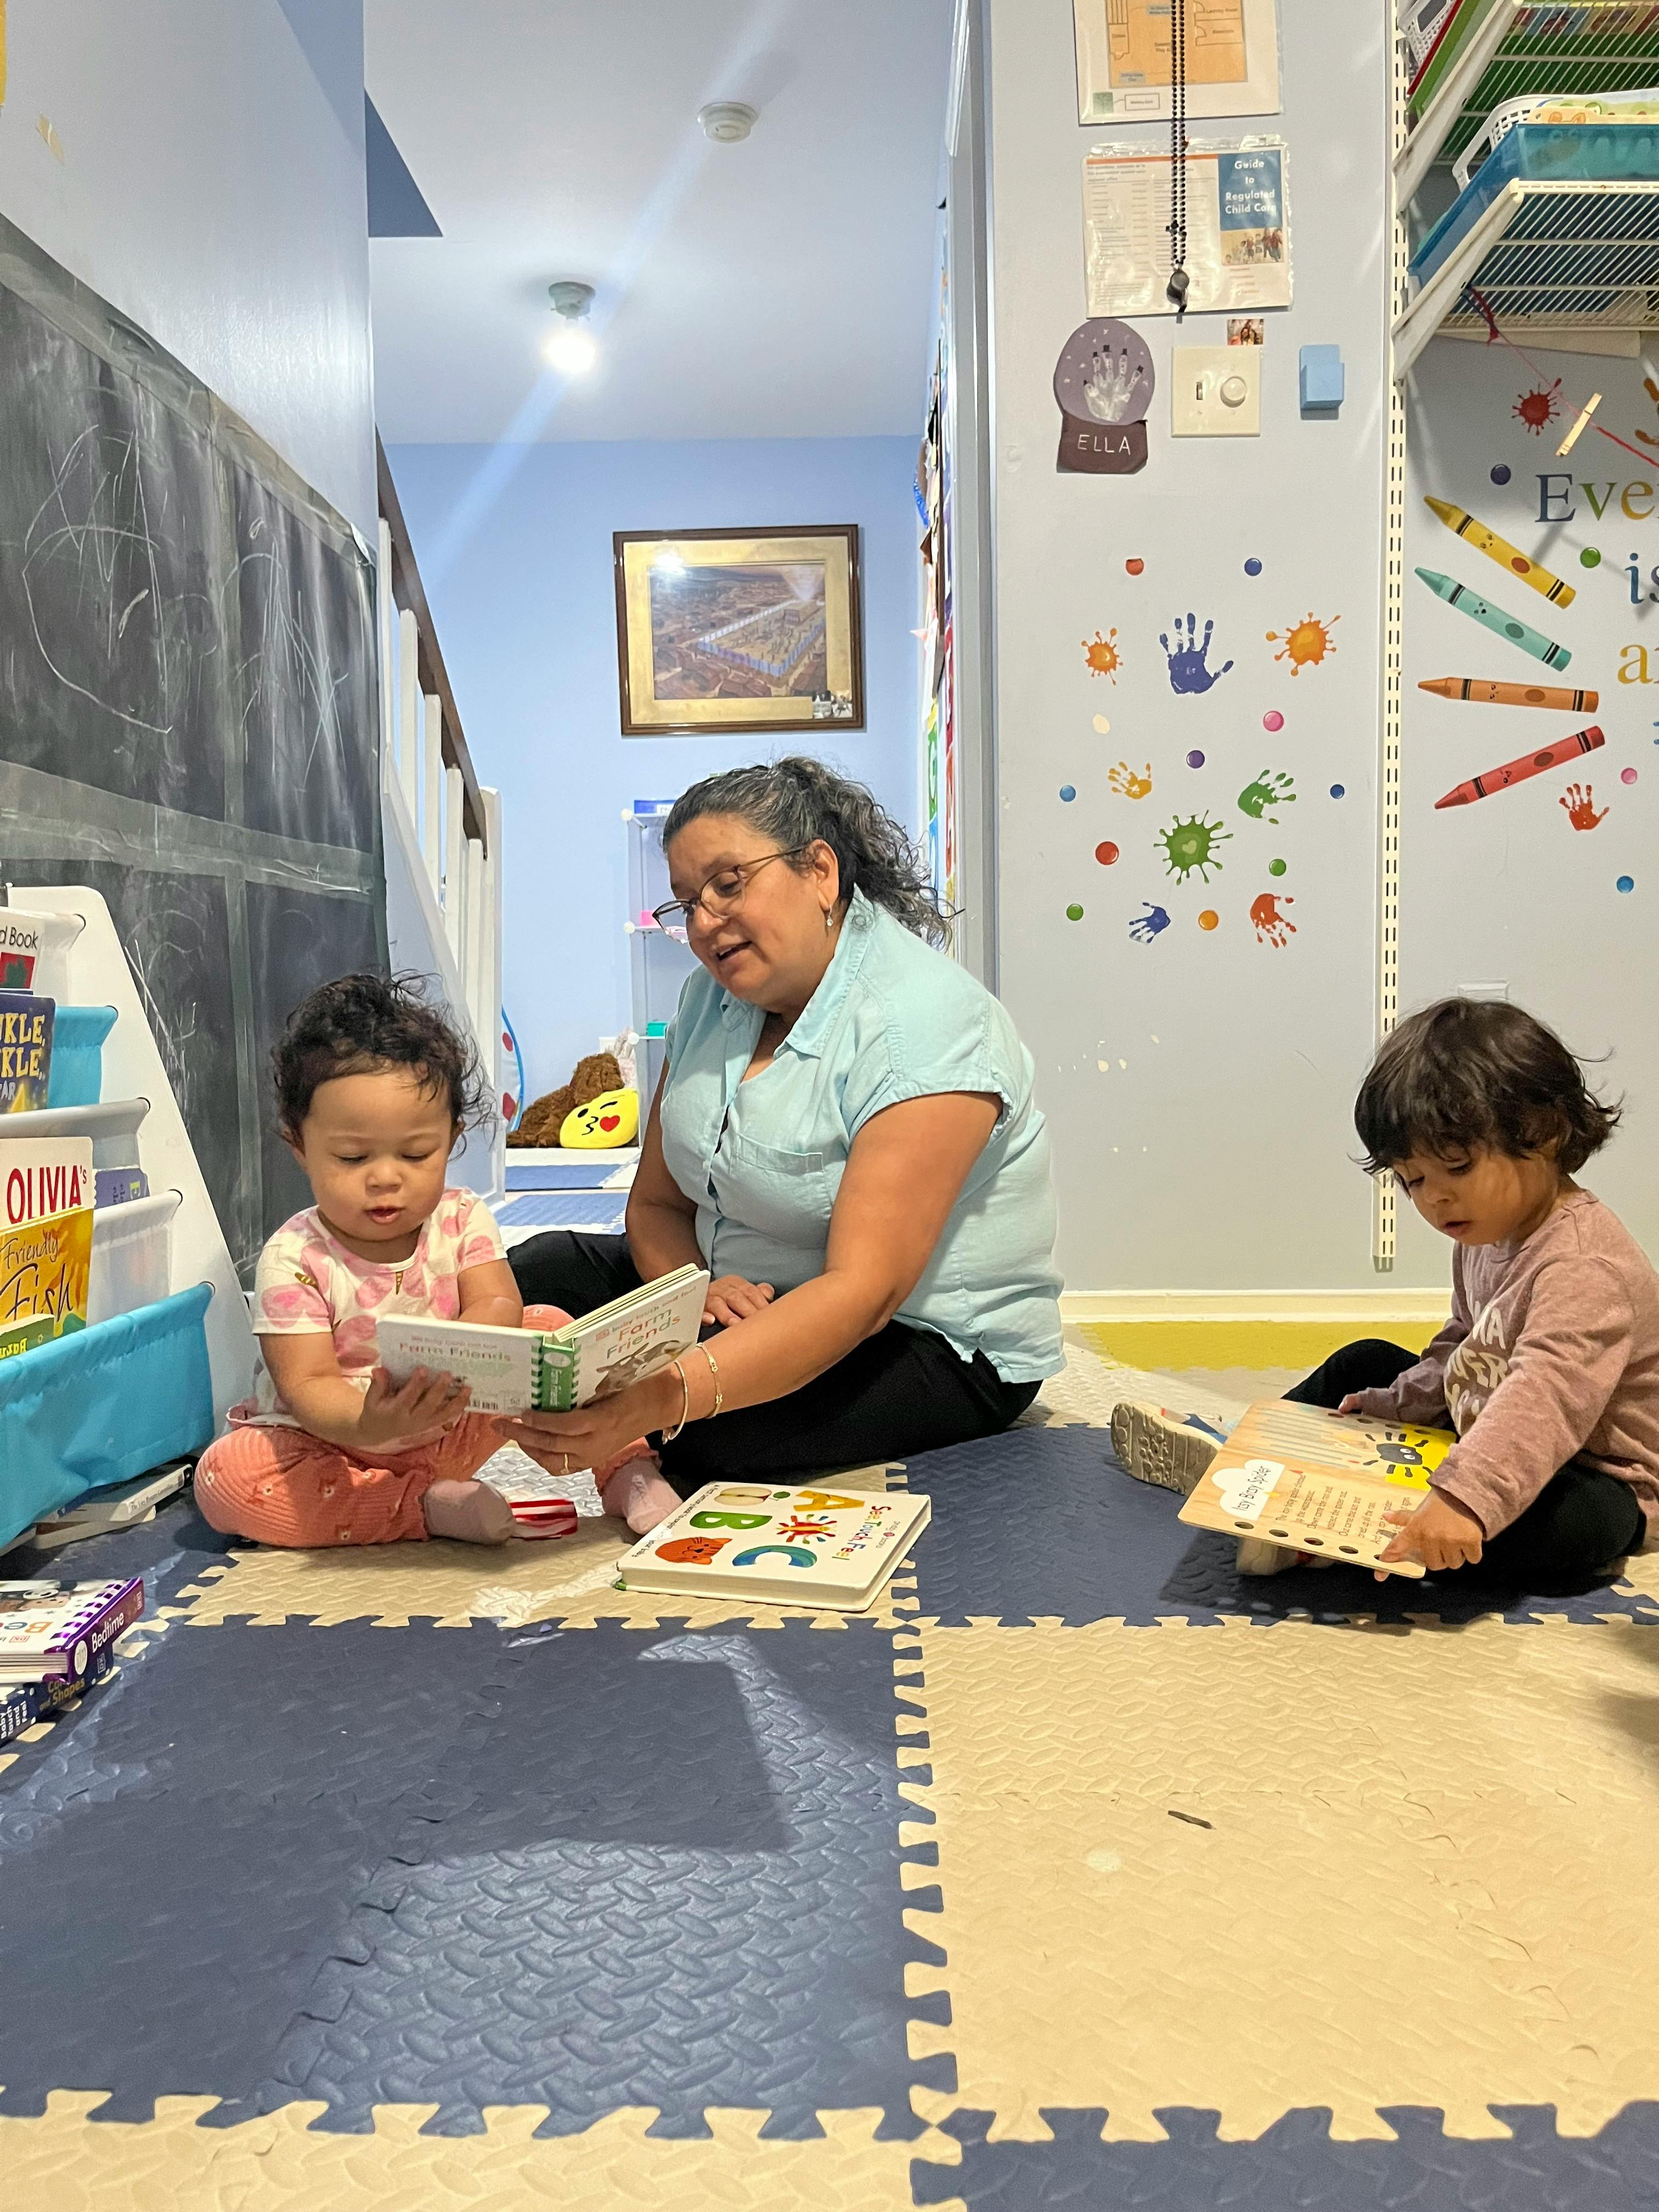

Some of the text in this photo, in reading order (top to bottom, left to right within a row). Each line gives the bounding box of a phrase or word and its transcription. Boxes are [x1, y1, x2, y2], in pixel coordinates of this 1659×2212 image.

[1234, 159, 1264, 170] Guide
[1245, 176, 1255, 184] to
[1226, 189, 1275, 202] Regulated
[1225, 202, 1277, 215] Child Care
[1077, 434, 1131, 455] ELLA
[1534, 473, 1659, 523] Eve
[10, 926, 40, 950] Book
[7, 1165, 87, 1224] OLIVIA's
[0, 1228, 59, 1269] Friendly
[0, 1263, 73, 1322] Fish
[619, 1309, 672, 1341] Farm
[607, 1316, 680, 1359] Friends
[450, 1346, 511, 1361] Friends
[794, 1490, 865, 1512] A
[690, 1511, 773, 1530] B
[732, 1545, 817, 1568] C
[832, 1543, 866, 1560] Feel
[92, 1612, 124, 1653] Bedtime
[53, 1678, 84, 1705] Shapes
